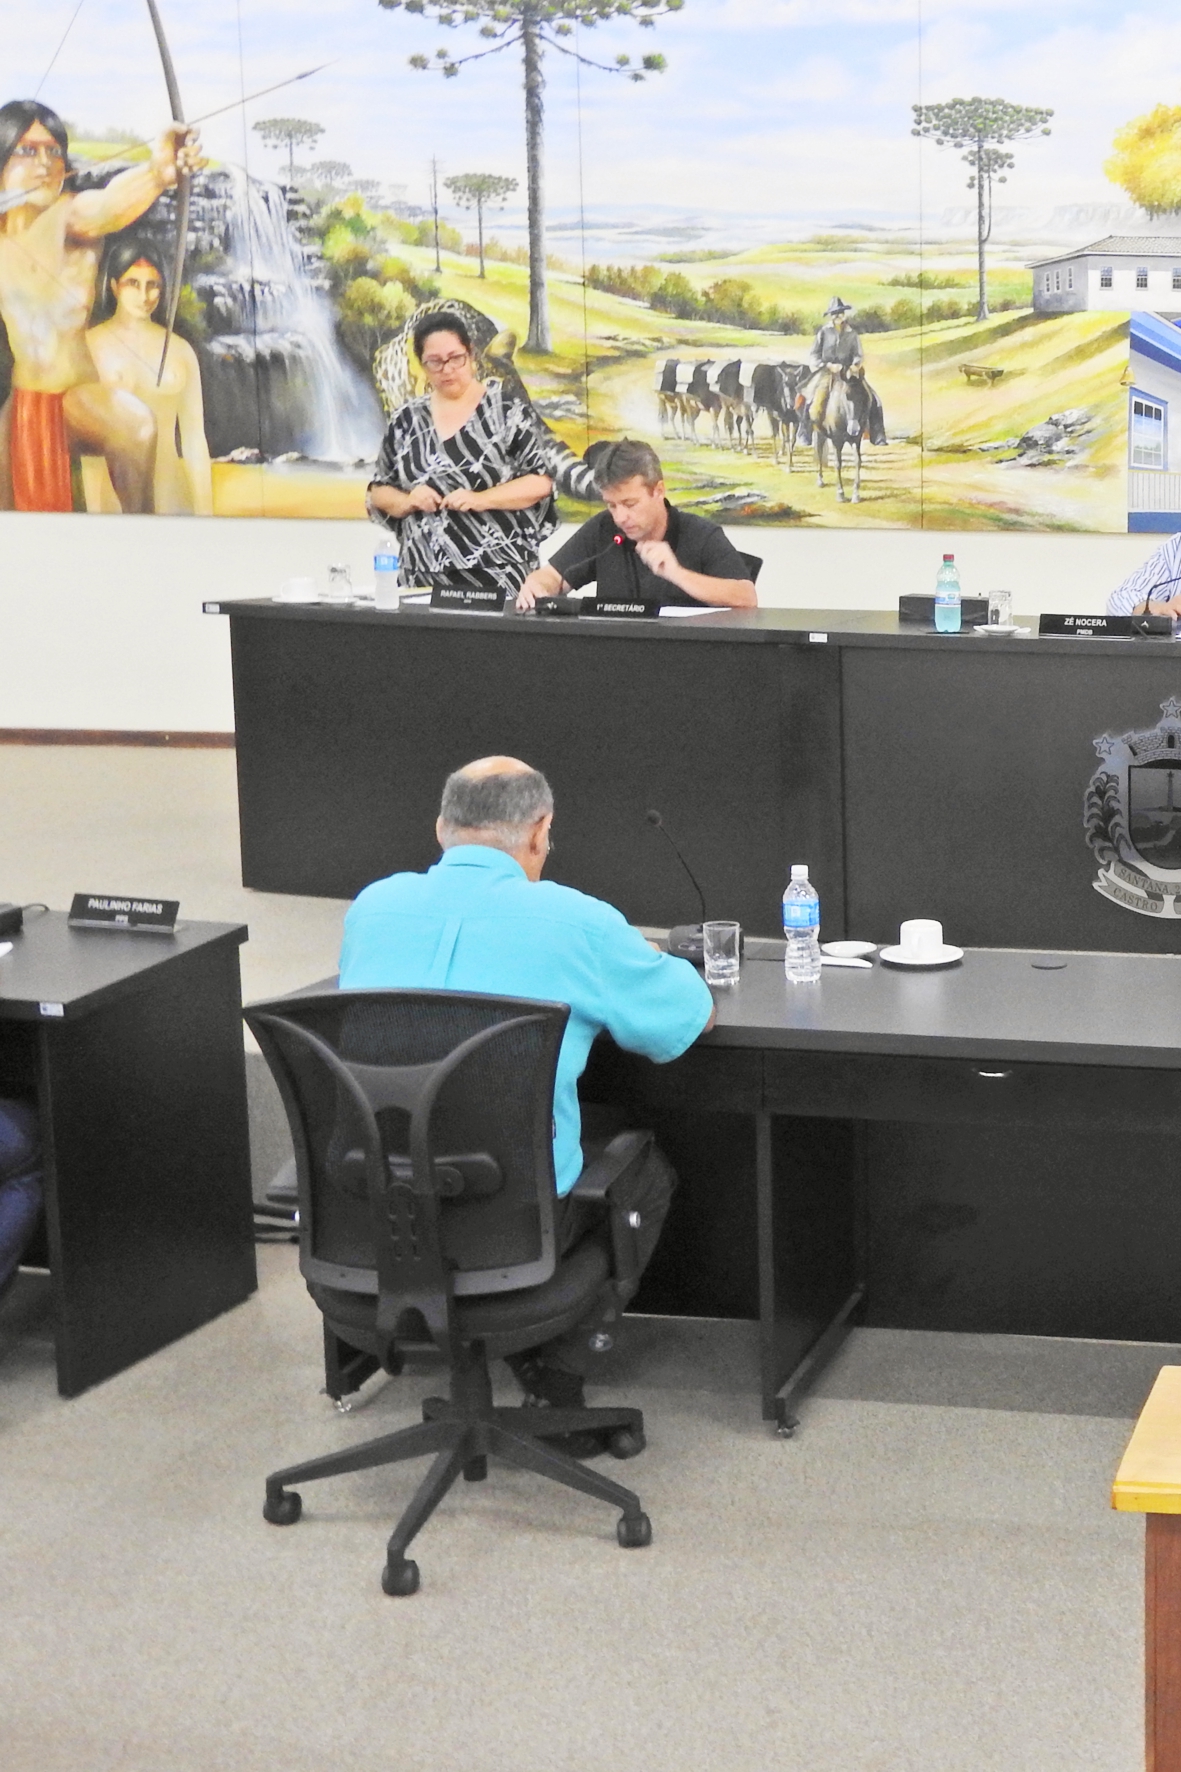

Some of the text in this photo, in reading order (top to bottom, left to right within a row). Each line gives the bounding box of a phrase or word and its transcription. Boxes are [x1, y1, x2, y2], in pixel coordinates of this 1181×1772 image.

[440, 589, 466, 599] RAFAEL
[604, 602, 645, 612] SECRETÁRIO
[1064, 617, 1108, 627] ZÉ NOCERA
[1113, 887, 1158, 911] CASTRO
[87, 898, 164, 915] PAULINHO FARIAS
